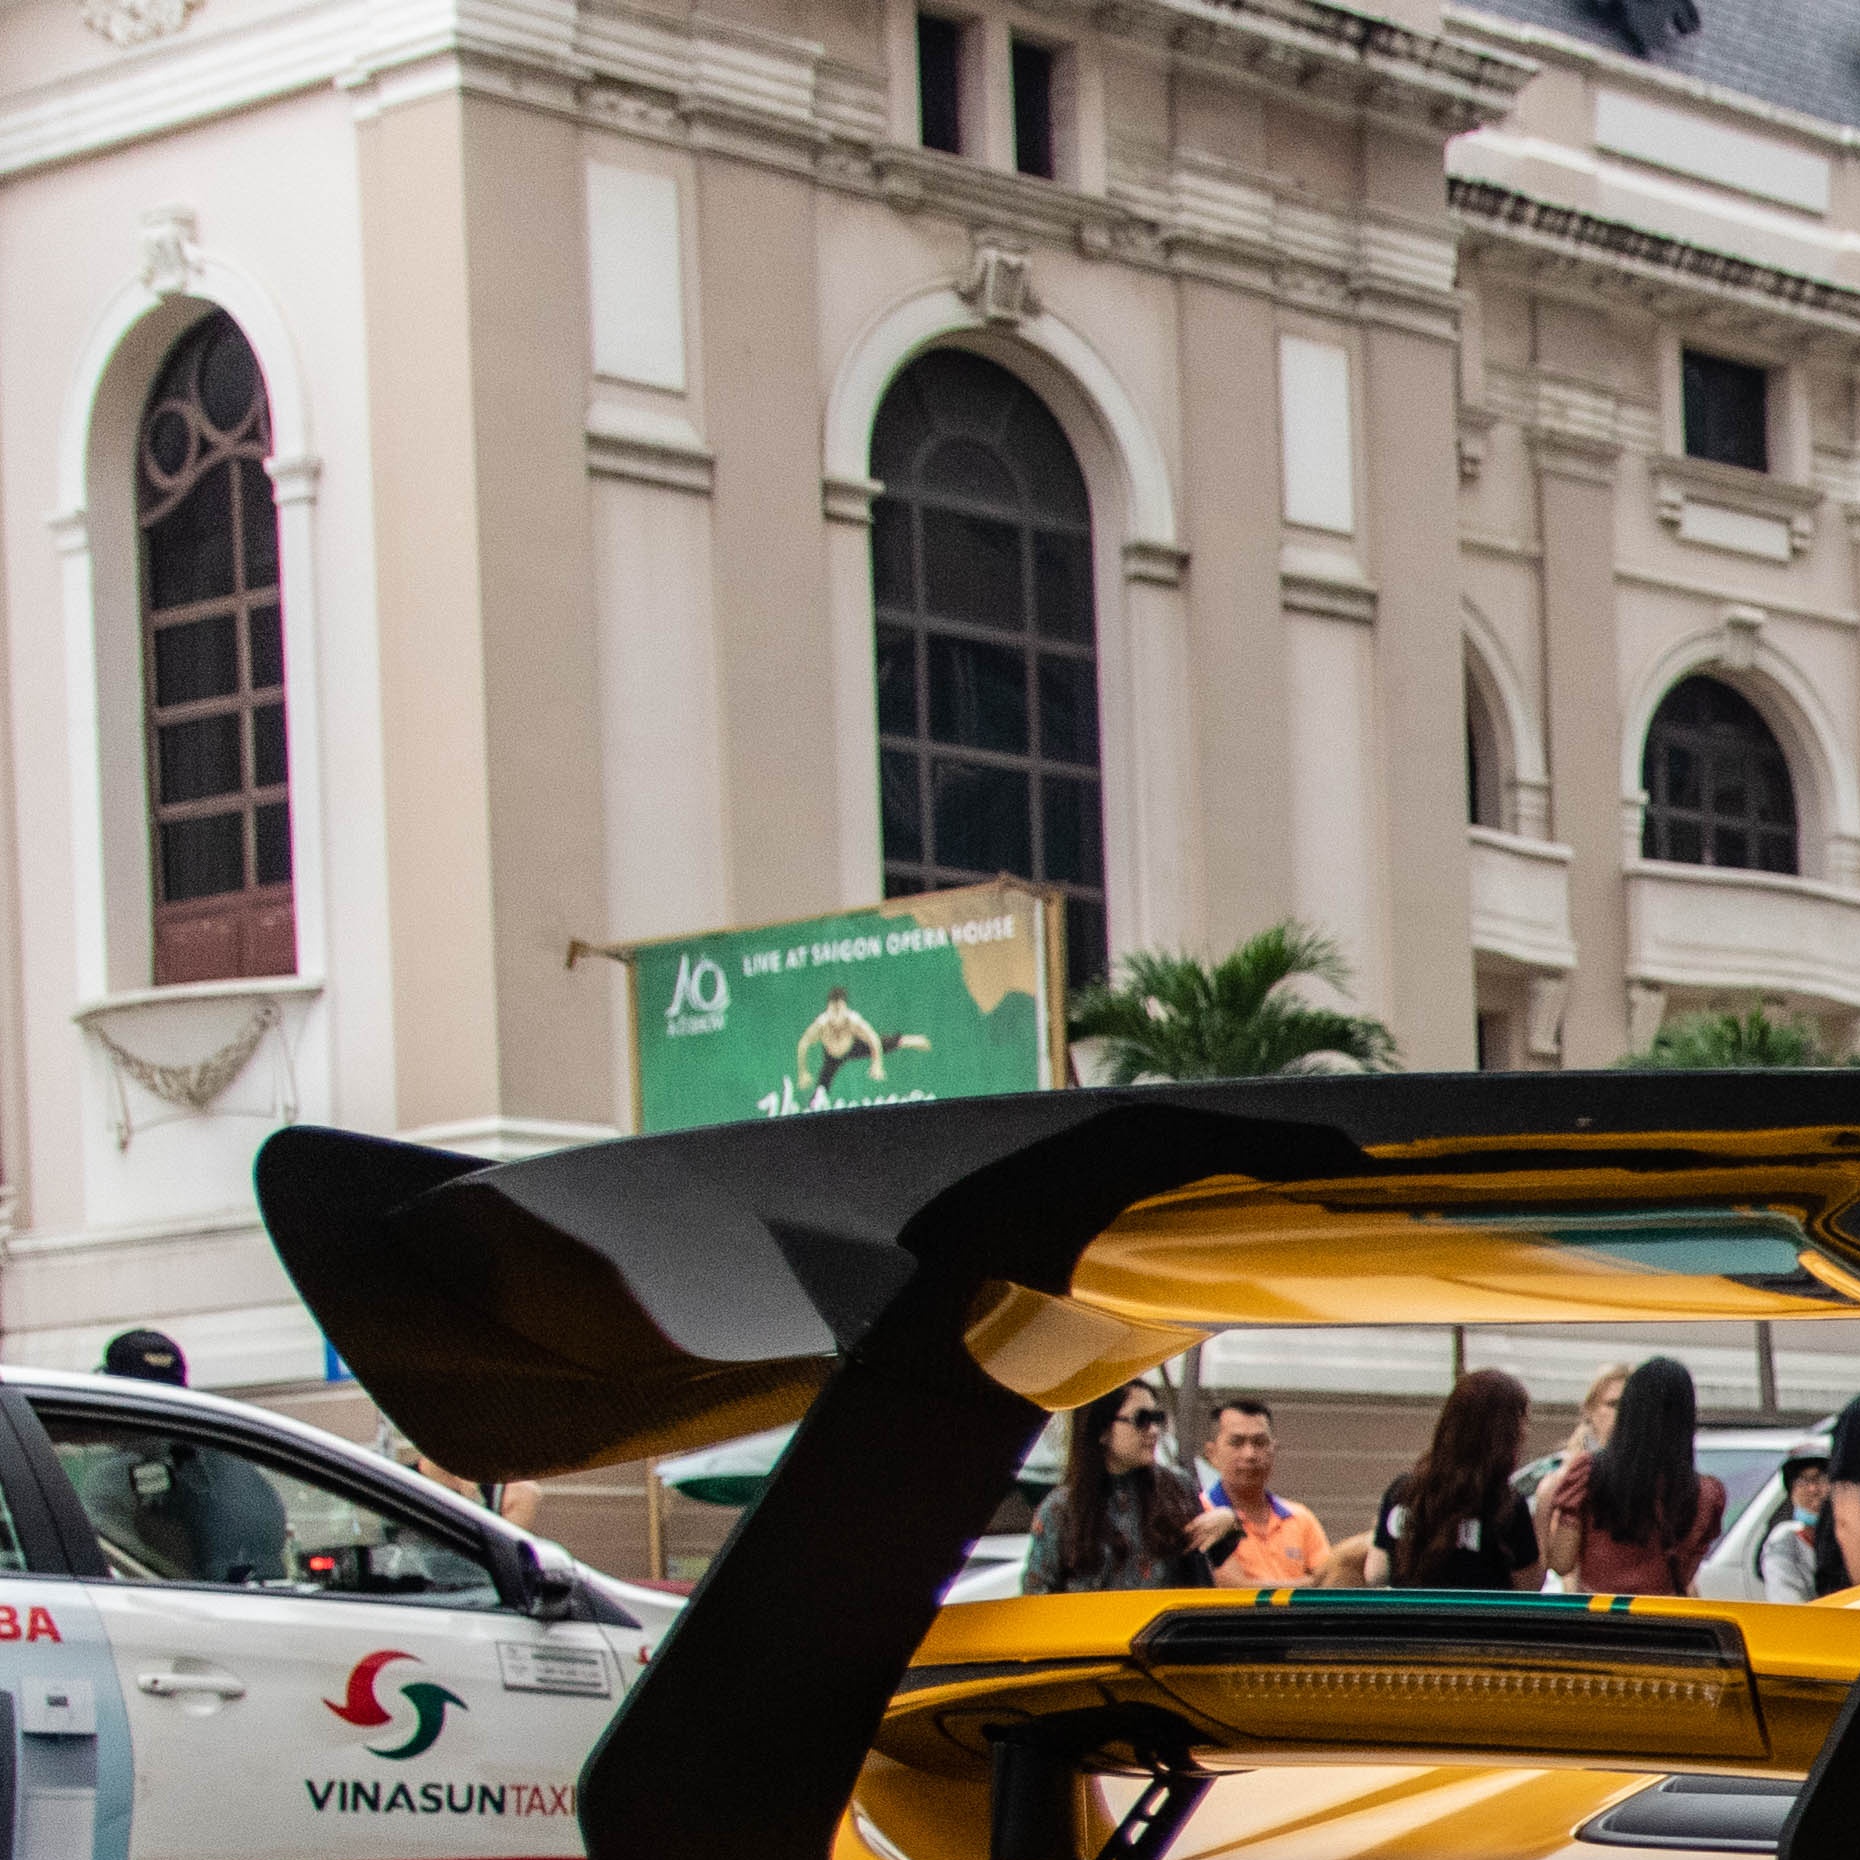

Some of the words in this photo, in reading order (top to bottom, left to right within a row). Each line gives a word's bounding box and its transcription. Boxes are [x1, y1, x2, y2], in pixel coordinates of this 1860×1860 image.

[742, 951, 781, 977] LIVE
[785, 945, 807, 970] AT
[811, 934, 882, 966] SAIGON
[886, 926, 949, 956] OPERA
[951, 914, 1015, 945] HOUSE
